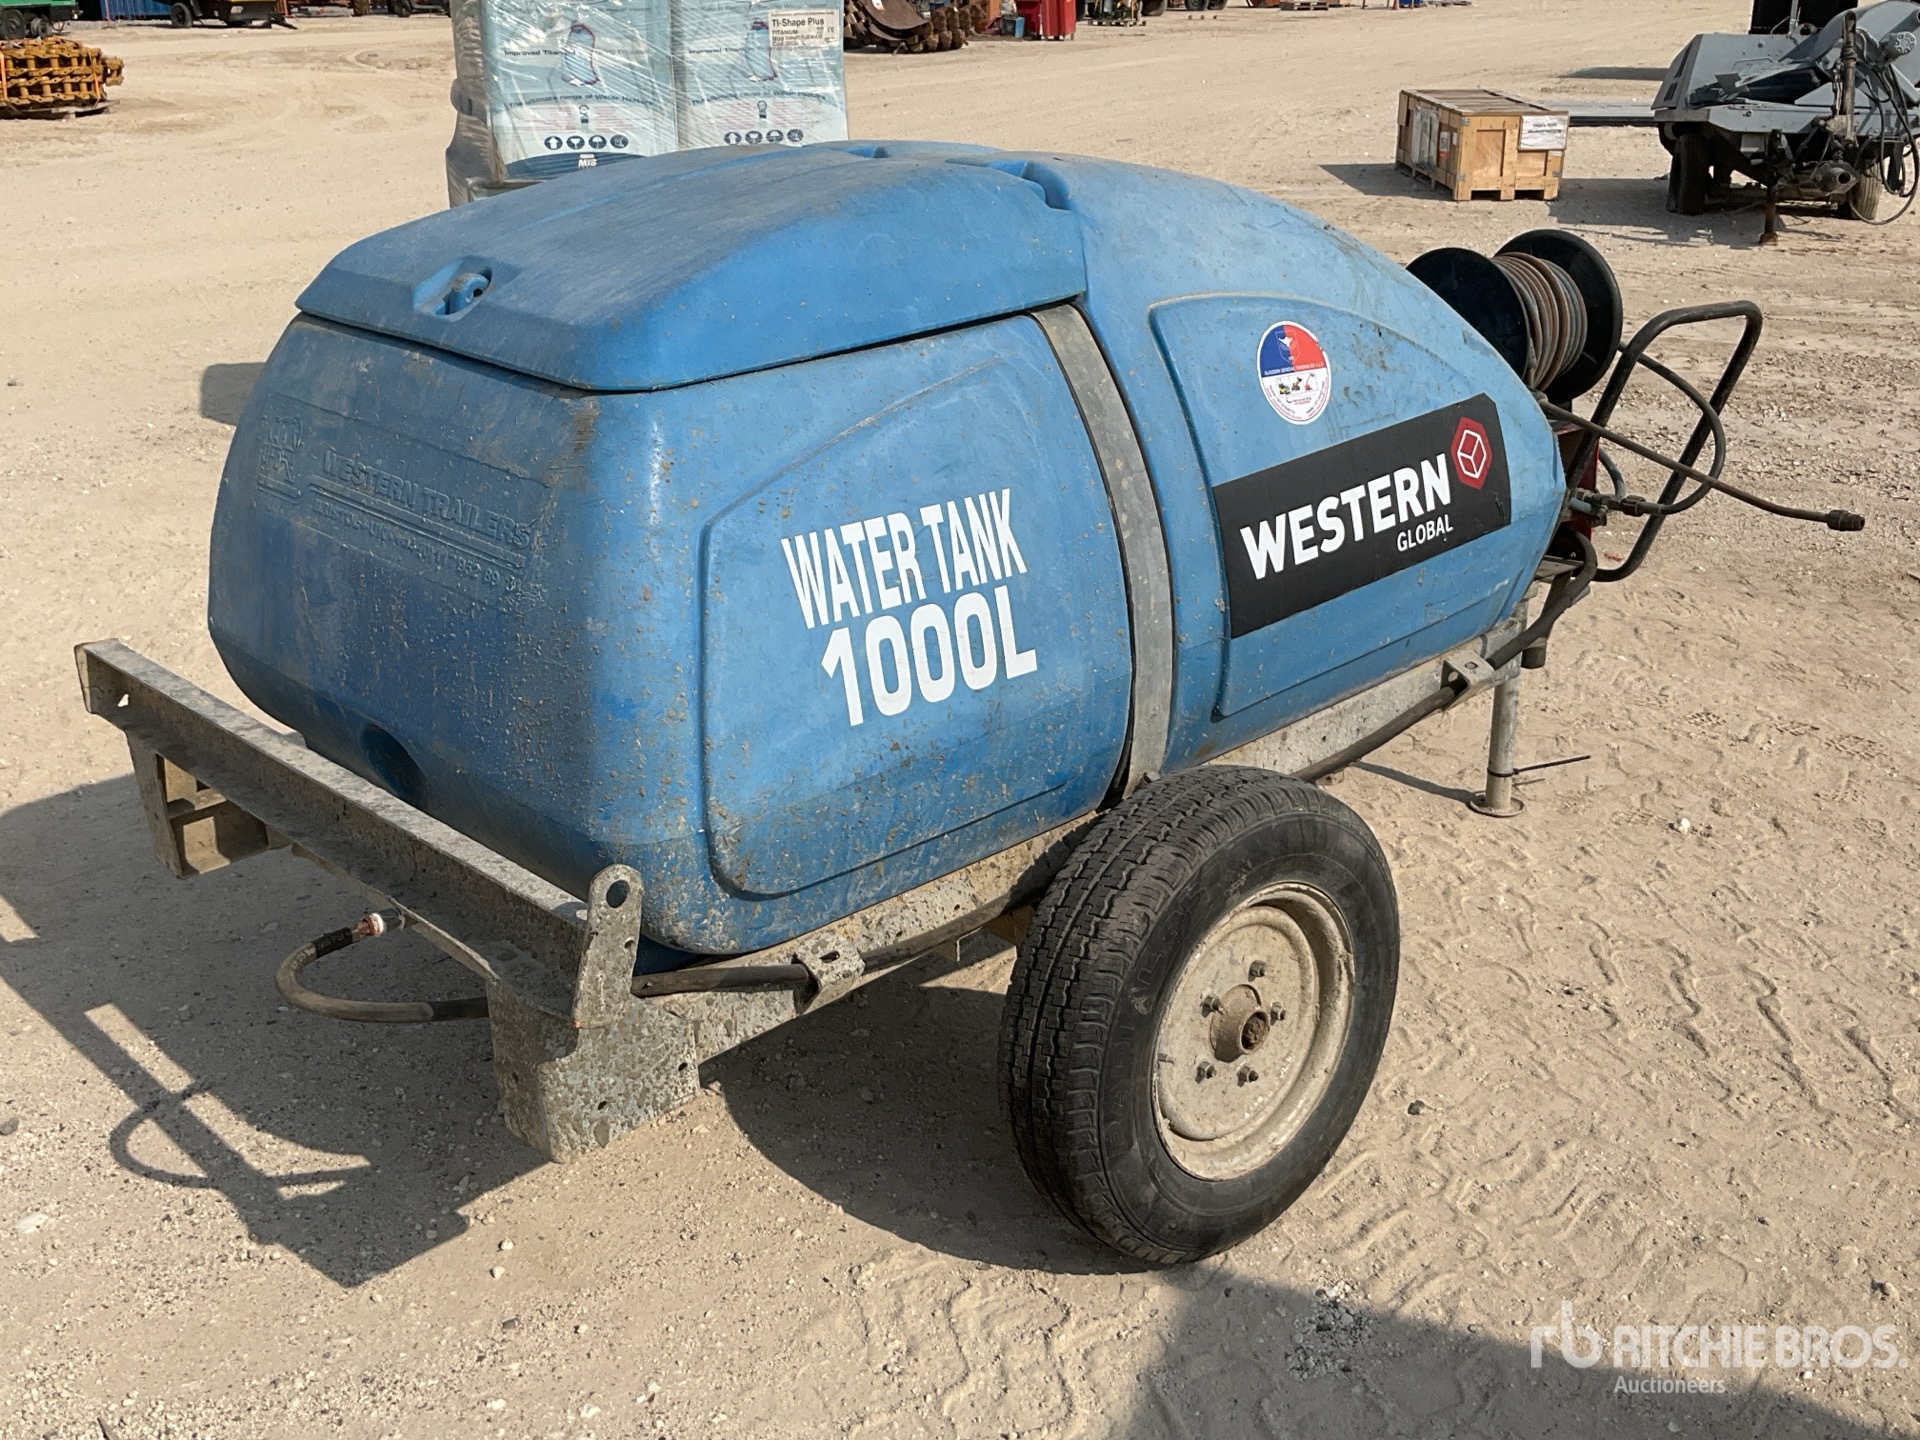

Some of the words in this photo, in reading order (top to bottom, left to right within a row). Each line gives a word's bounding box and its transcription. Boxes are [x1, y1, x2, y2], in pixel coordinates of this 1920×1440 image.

[808, 17, 825, 26] Plus
[509, 101, 523, 109] The
[525, 95, 558, 105] ultimate
[692, 98, 704, 106] The
[578, 159, 597, 168] MTS
[323, 449, 419, 508] WESTERN
[422, 487, 532, 550] TRAILERS
[1240, 452, 1451, 580] WESTERN
[1397, 514, 1453, 551] GLOBAL
[781, 512, 927, 629] WATER
[920, 488, 1027, 593] TANK
[821, 585, 1037, 726] 1000L
